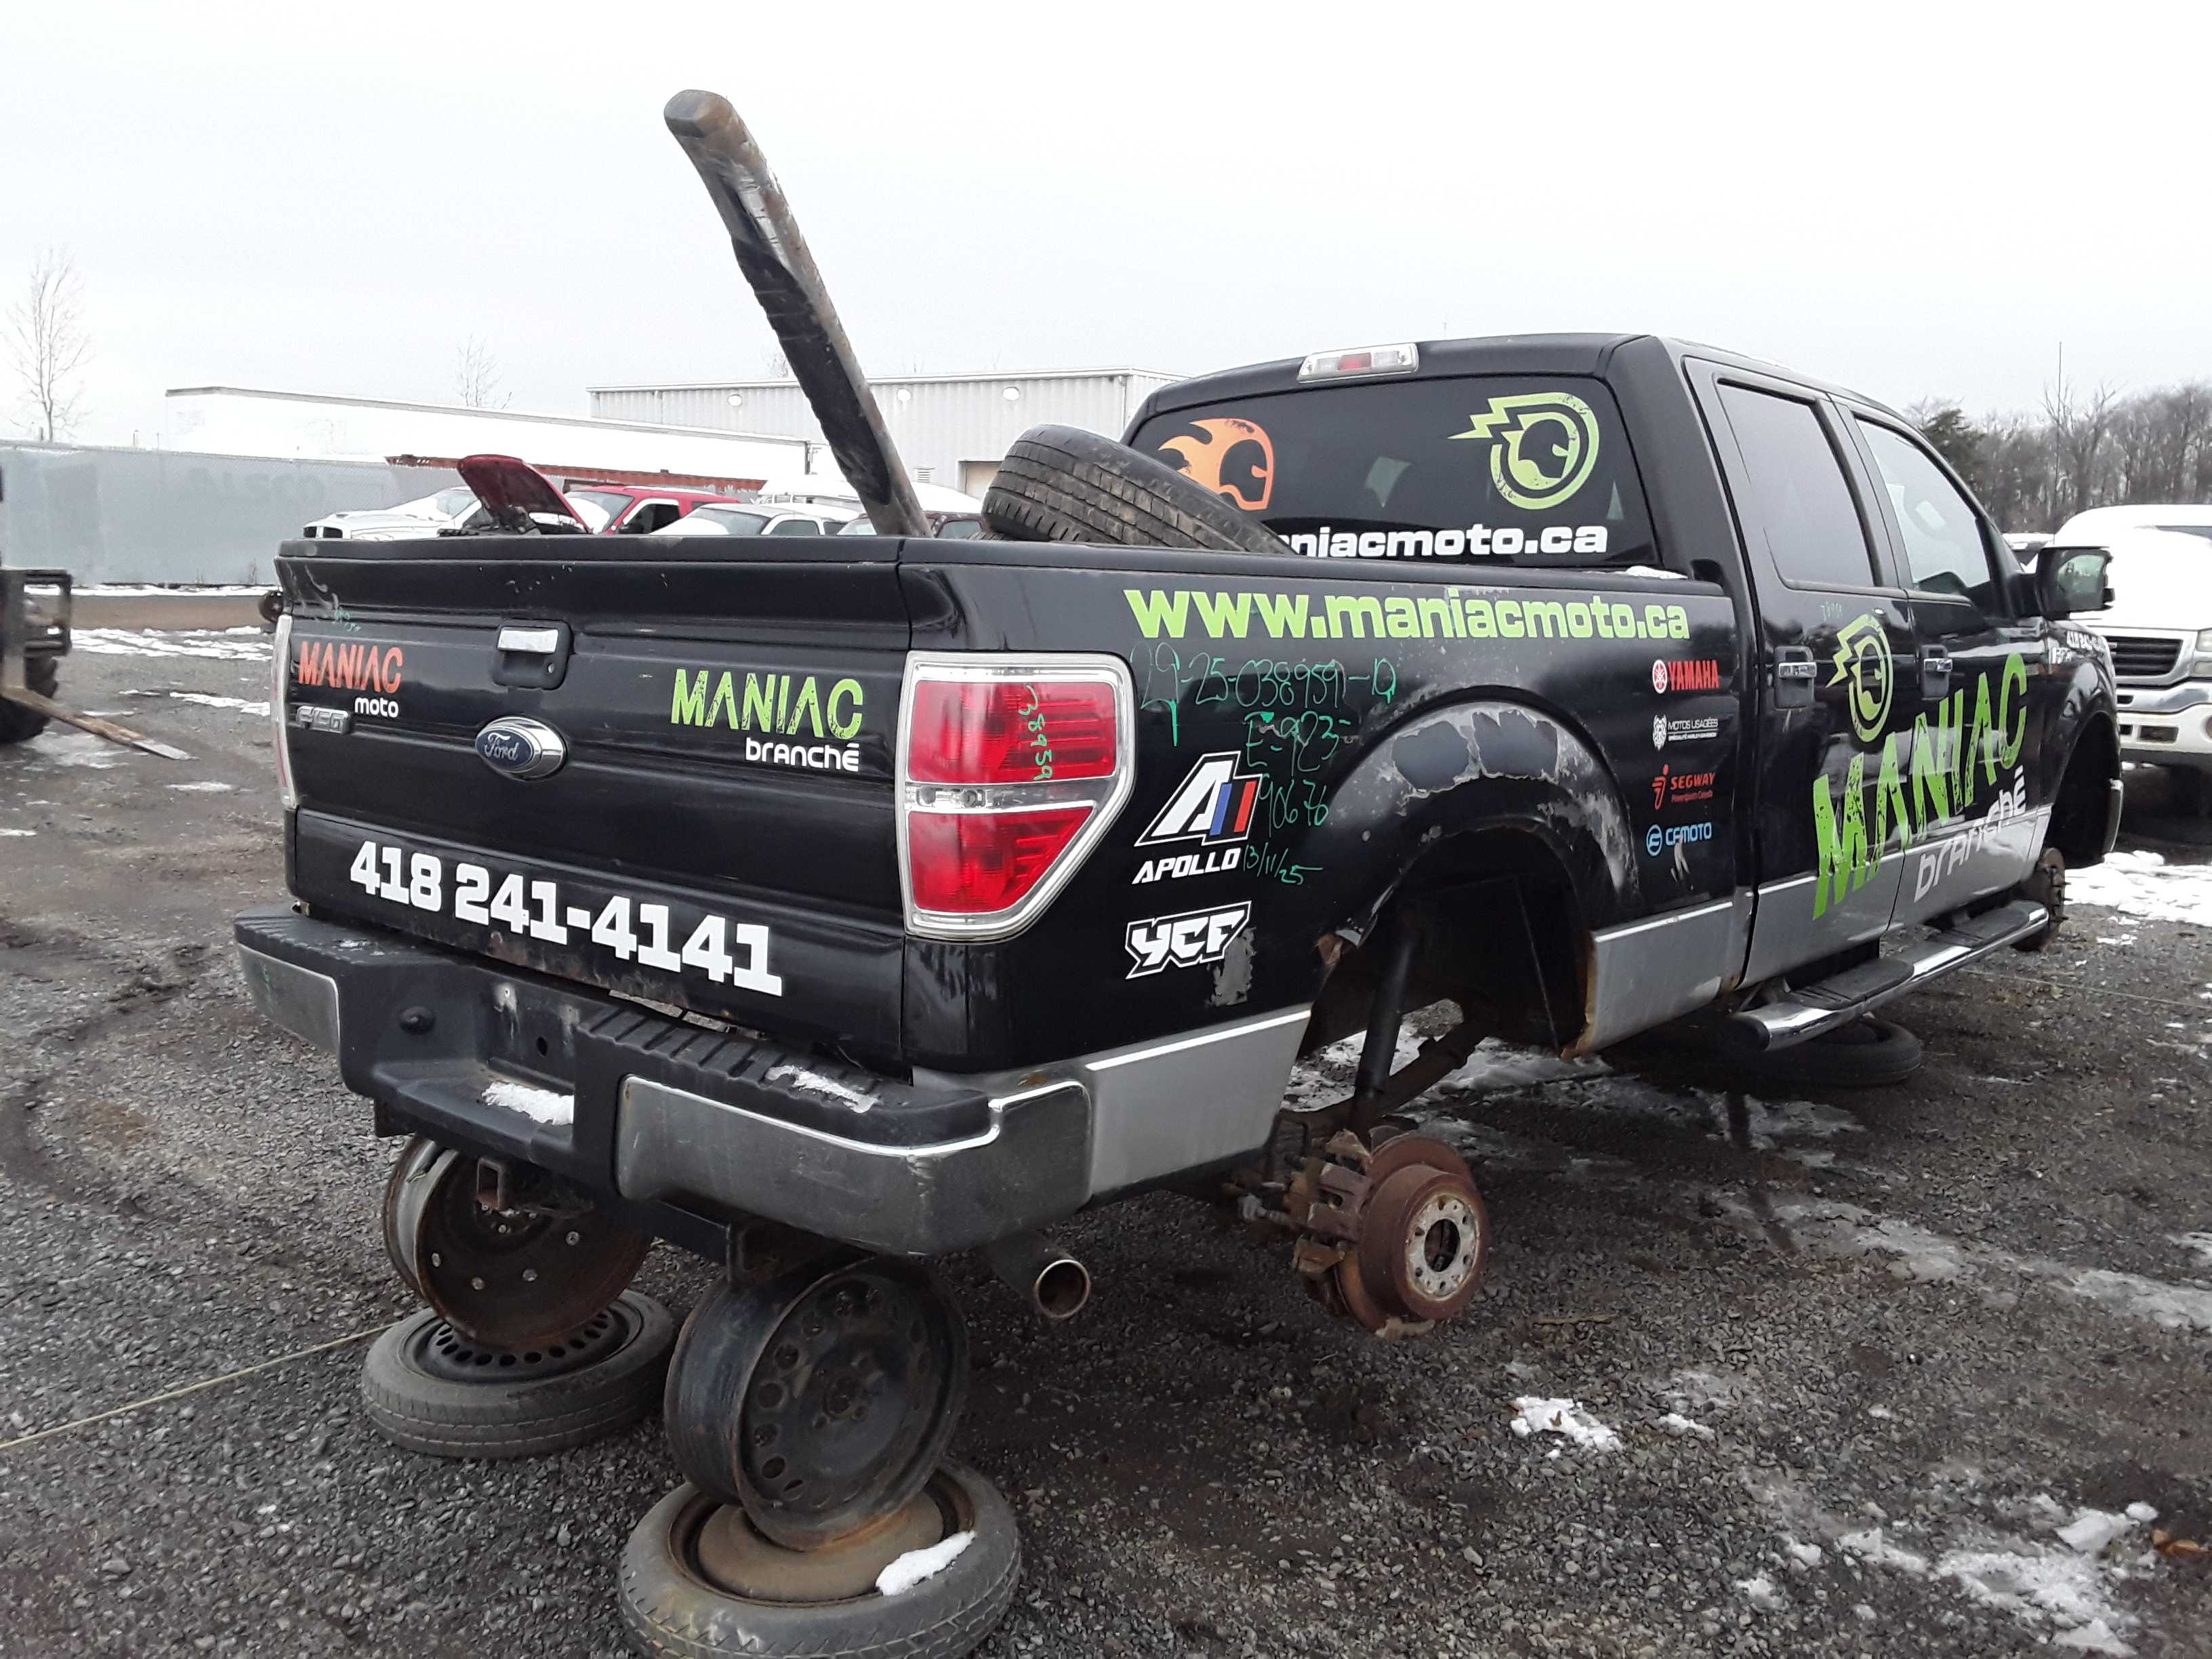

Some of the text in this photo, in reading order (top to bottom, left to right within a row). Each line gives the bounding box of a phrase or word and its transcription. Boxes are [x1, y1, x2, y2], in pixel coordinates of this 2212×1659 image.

[1124, 588, 1690, 639] www.maniacmoto.ca
[298, 641, 403, 694] MANIAC
[1667, 660, 1720, 691] YAMAHA
[354, 697, 399, 718] moto
[671, 668, 864, 739] MANIAC
[1018, 684, 1052, 781] 38959
[1668, 720, 1691, 731] MOTOS
[484, 732, 520, 761] Ford
[1670, 773, 1716, 790] SEGWAY
[1814, 652, 2028, 920] MANIAC
[1665, 822, 1712, 846] CFMOTO
[1132, 848, 1242, 884] APOLLO
[350, 840, 782, 997] 418 241-4141
